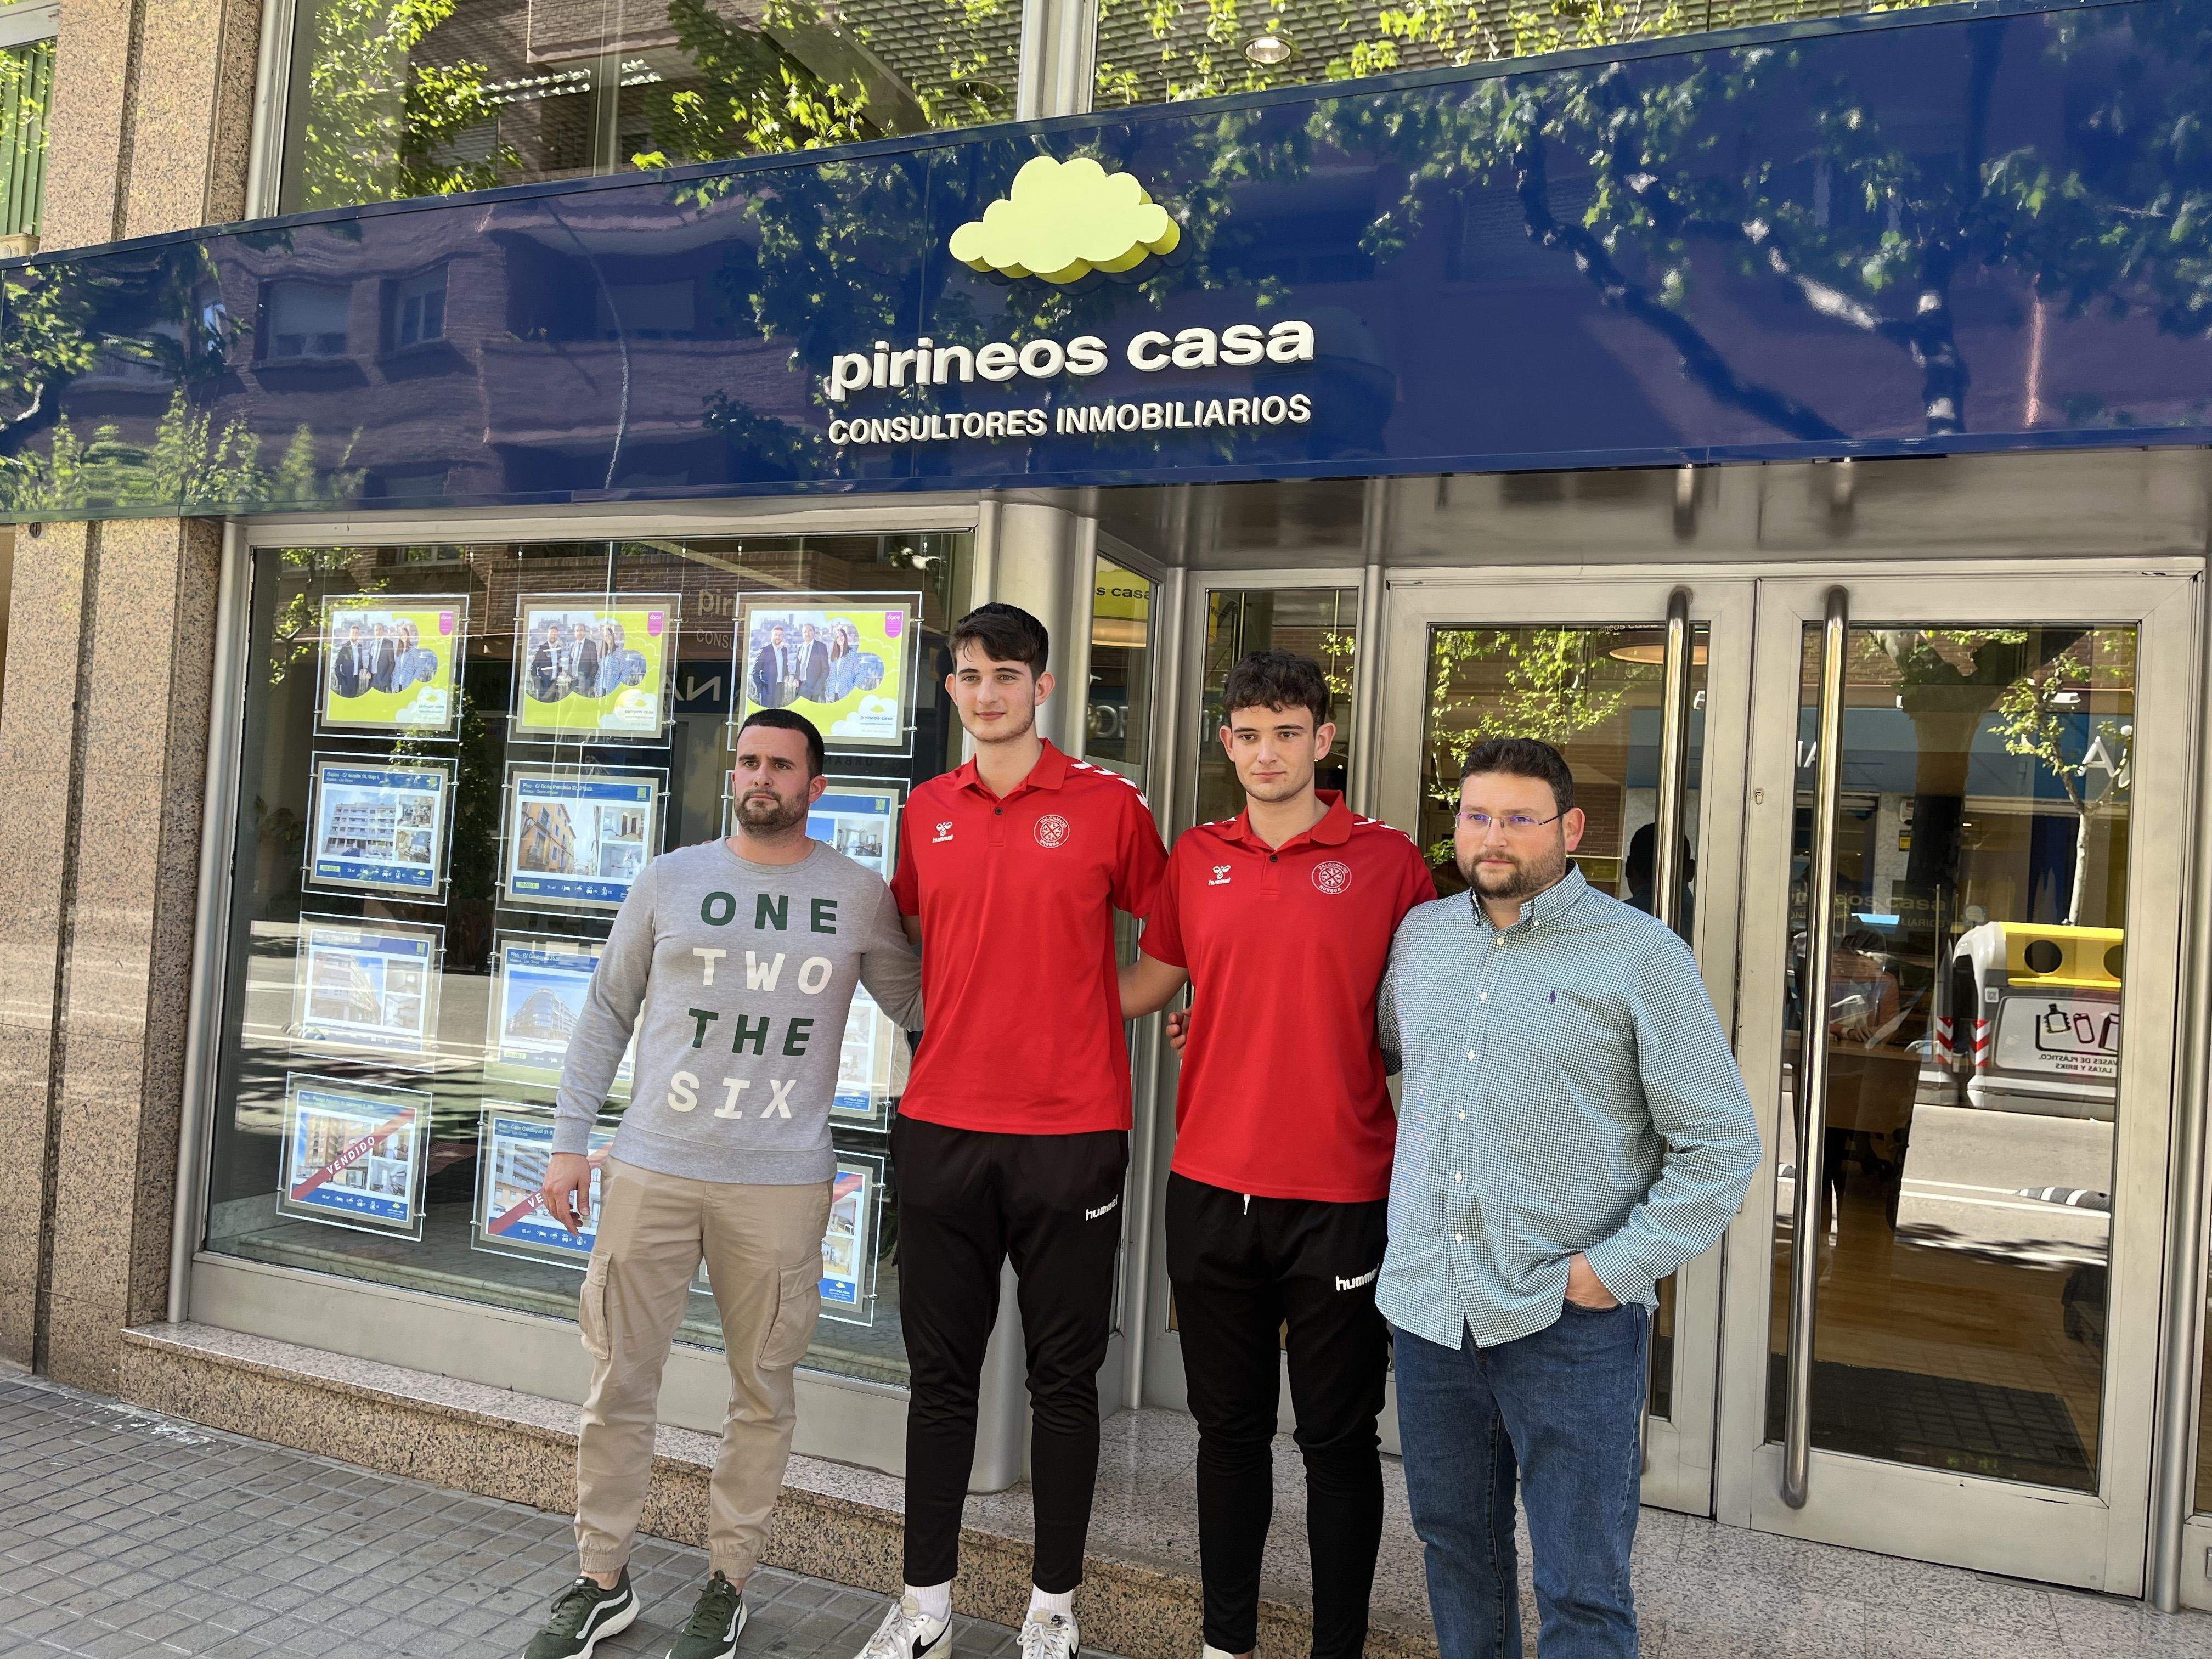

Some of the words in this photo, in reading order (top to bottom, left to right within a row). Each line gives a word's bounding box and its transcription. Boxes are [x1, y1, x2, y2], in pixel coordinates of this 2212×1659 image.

[830, 335, 1108, 402] pirineos
[1127, 320, 1314, 372] casa
[828, 409, 1047, 446] CONSULTORES
[1056, 393, 1311, 435] INMOBILIARIOS
[933, 834, 953, 843] hummel
[1208, 877, 1231, 886] hummel
[1318, 863, 1349, 874] BALONMANO
[701, 891, 838, 934] ONE
[693, 947, 833, 995] TWO
[689, 1008, 814, 1056] THE
[668, 1071, 797, 1119] SIX
[326, 1136, 375, 1175] VENDIDO
[1085, 1194, 1119, 1221] hummel
